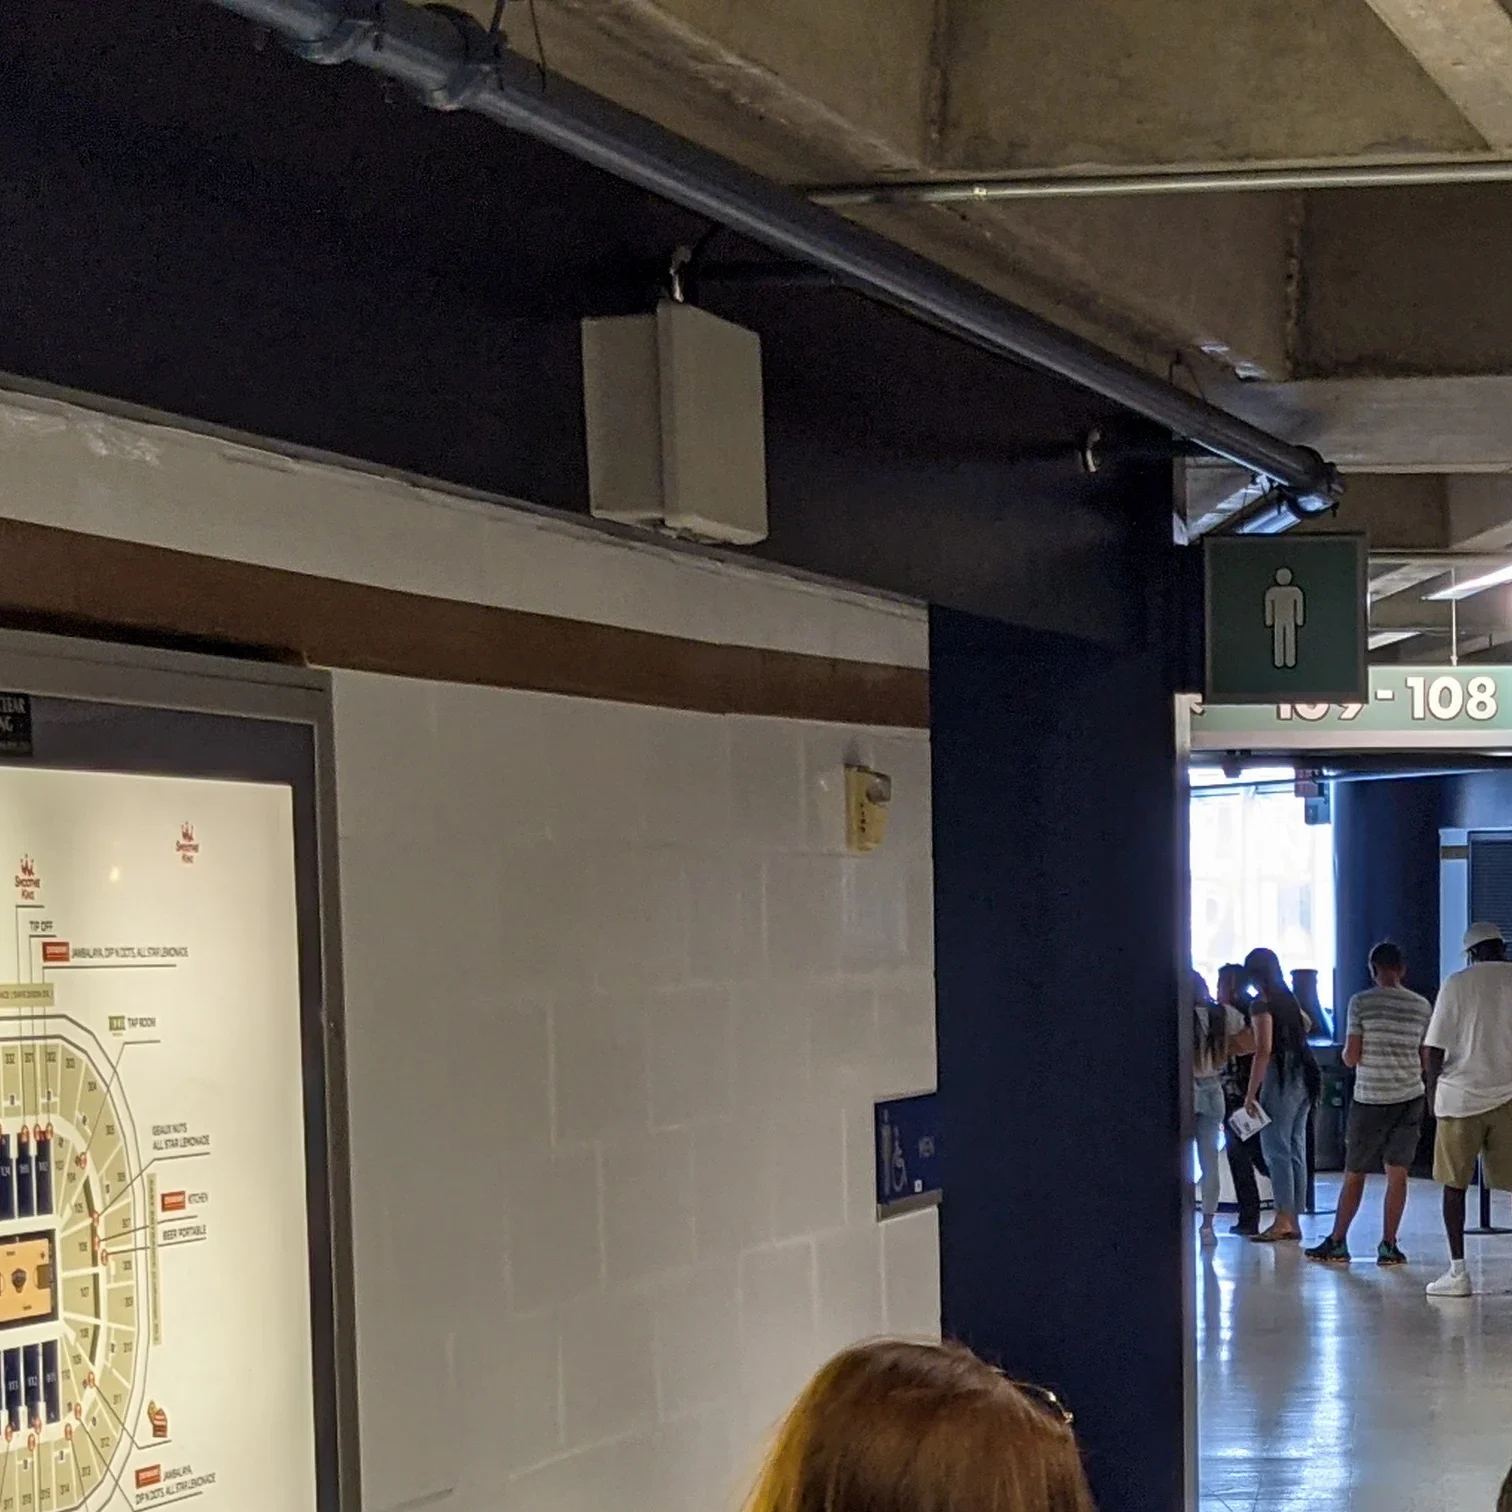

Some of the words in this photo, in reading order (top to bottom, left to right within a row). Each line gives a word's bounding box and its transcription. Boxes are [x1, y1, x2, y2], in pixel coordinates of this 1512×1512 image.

[1406, 676, 1498, 721] 108
[153, 1140, 164, 1150] ALL
[165, 1138, 178, 1150] STAR
[163, 1228, 177, 1240] BEER
[179, 1224, 207, 1237] PORTABLE
